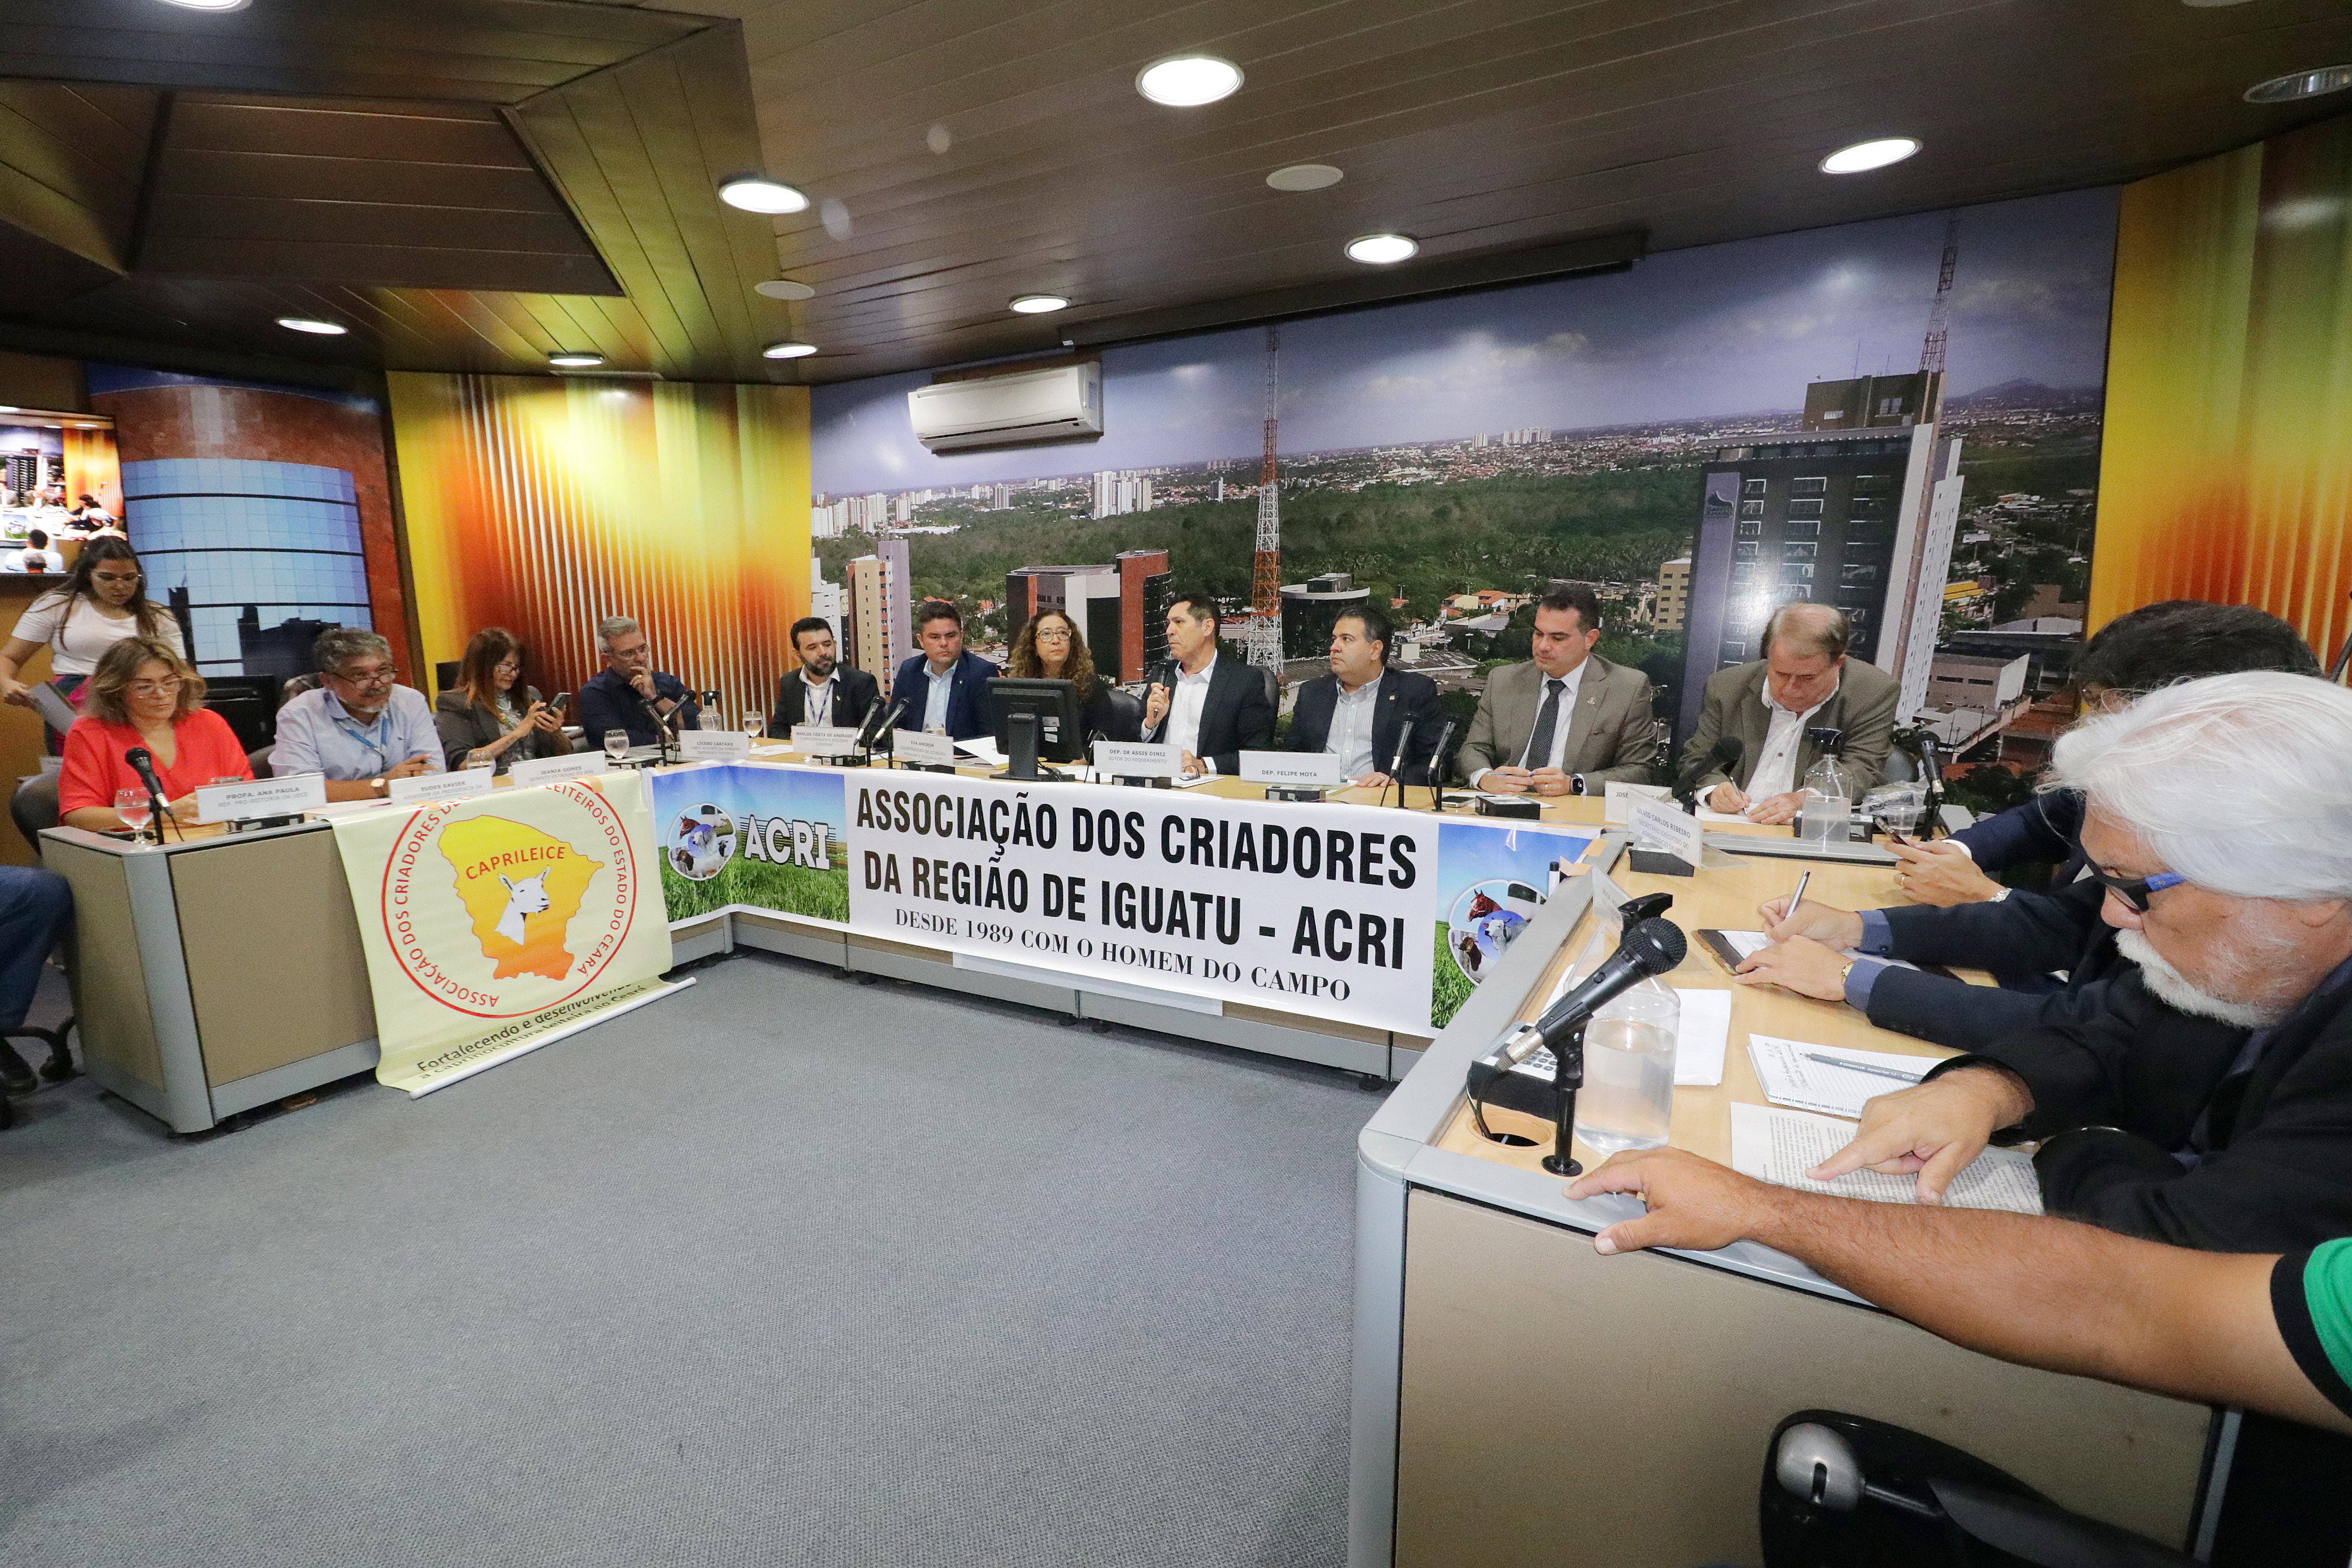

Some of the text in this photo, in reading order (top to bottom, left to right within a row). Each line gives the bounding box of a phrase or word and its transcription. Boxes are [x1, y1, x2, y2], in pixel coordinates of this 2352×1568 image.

[604, 825, 619, 846] DO
[744, 814, 831, 871] ACRI
[857, 789, 1416, 889] ASSOCIAÇÃO DOS CRIADORES
[1652, 815, 1669, 828] CARLOS
[1670, 824, 1690, 838] RIBEIRO
[395, 816, 440, 905] CRIADORES
[466, 846, 566, 880] CAPRILEICE
[613, 849, 628, 904] ESTADO
[396, 910, 416, 945] DOS
[610, 909, 625, 931] DO
[864, 851, 1404, 970] DA REGIÃO DE IGUATU - ACRI
[410, 948, 499, 1008] ASSOCIAÇÃO
[577, 933, 614, 978] CEARÁ
[895, 909, 1351, 1001] DESDE 1989 COM O HOMEM DO CAMPO
[542, 1010, 592, 1029] leiteira
[593, 1001, 610, 1010] no
[611, 985, 647, 1002] Ceará
[417, 1025, 520, 1072] Fortalecendo
[522, 1020, 532, 1029] e
